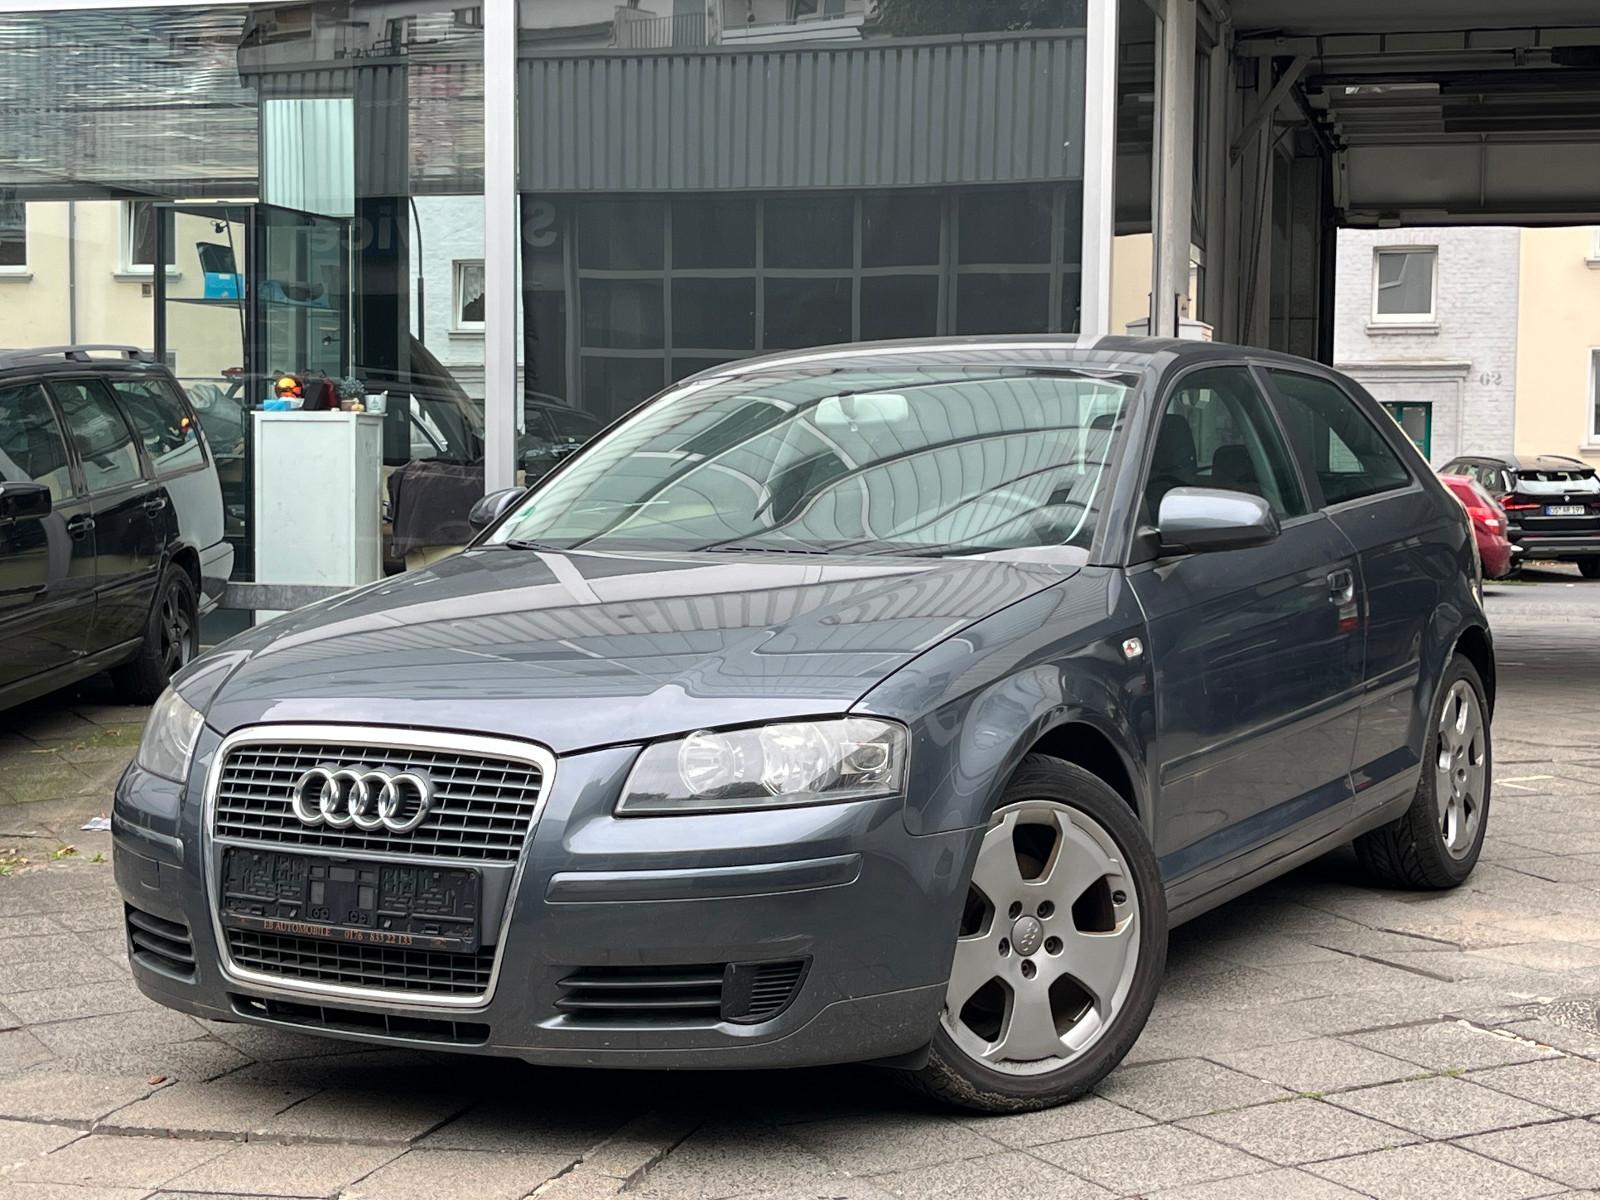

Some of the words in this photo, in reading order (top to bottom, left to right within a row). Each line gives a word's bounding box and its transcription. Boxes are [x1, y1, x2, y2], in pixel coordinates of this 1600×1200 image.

[1480, 370, 1503, 386] 62
[275, 922, 333, 937] AUTOMOBILE
[344, 929, 363, 941] 0176
